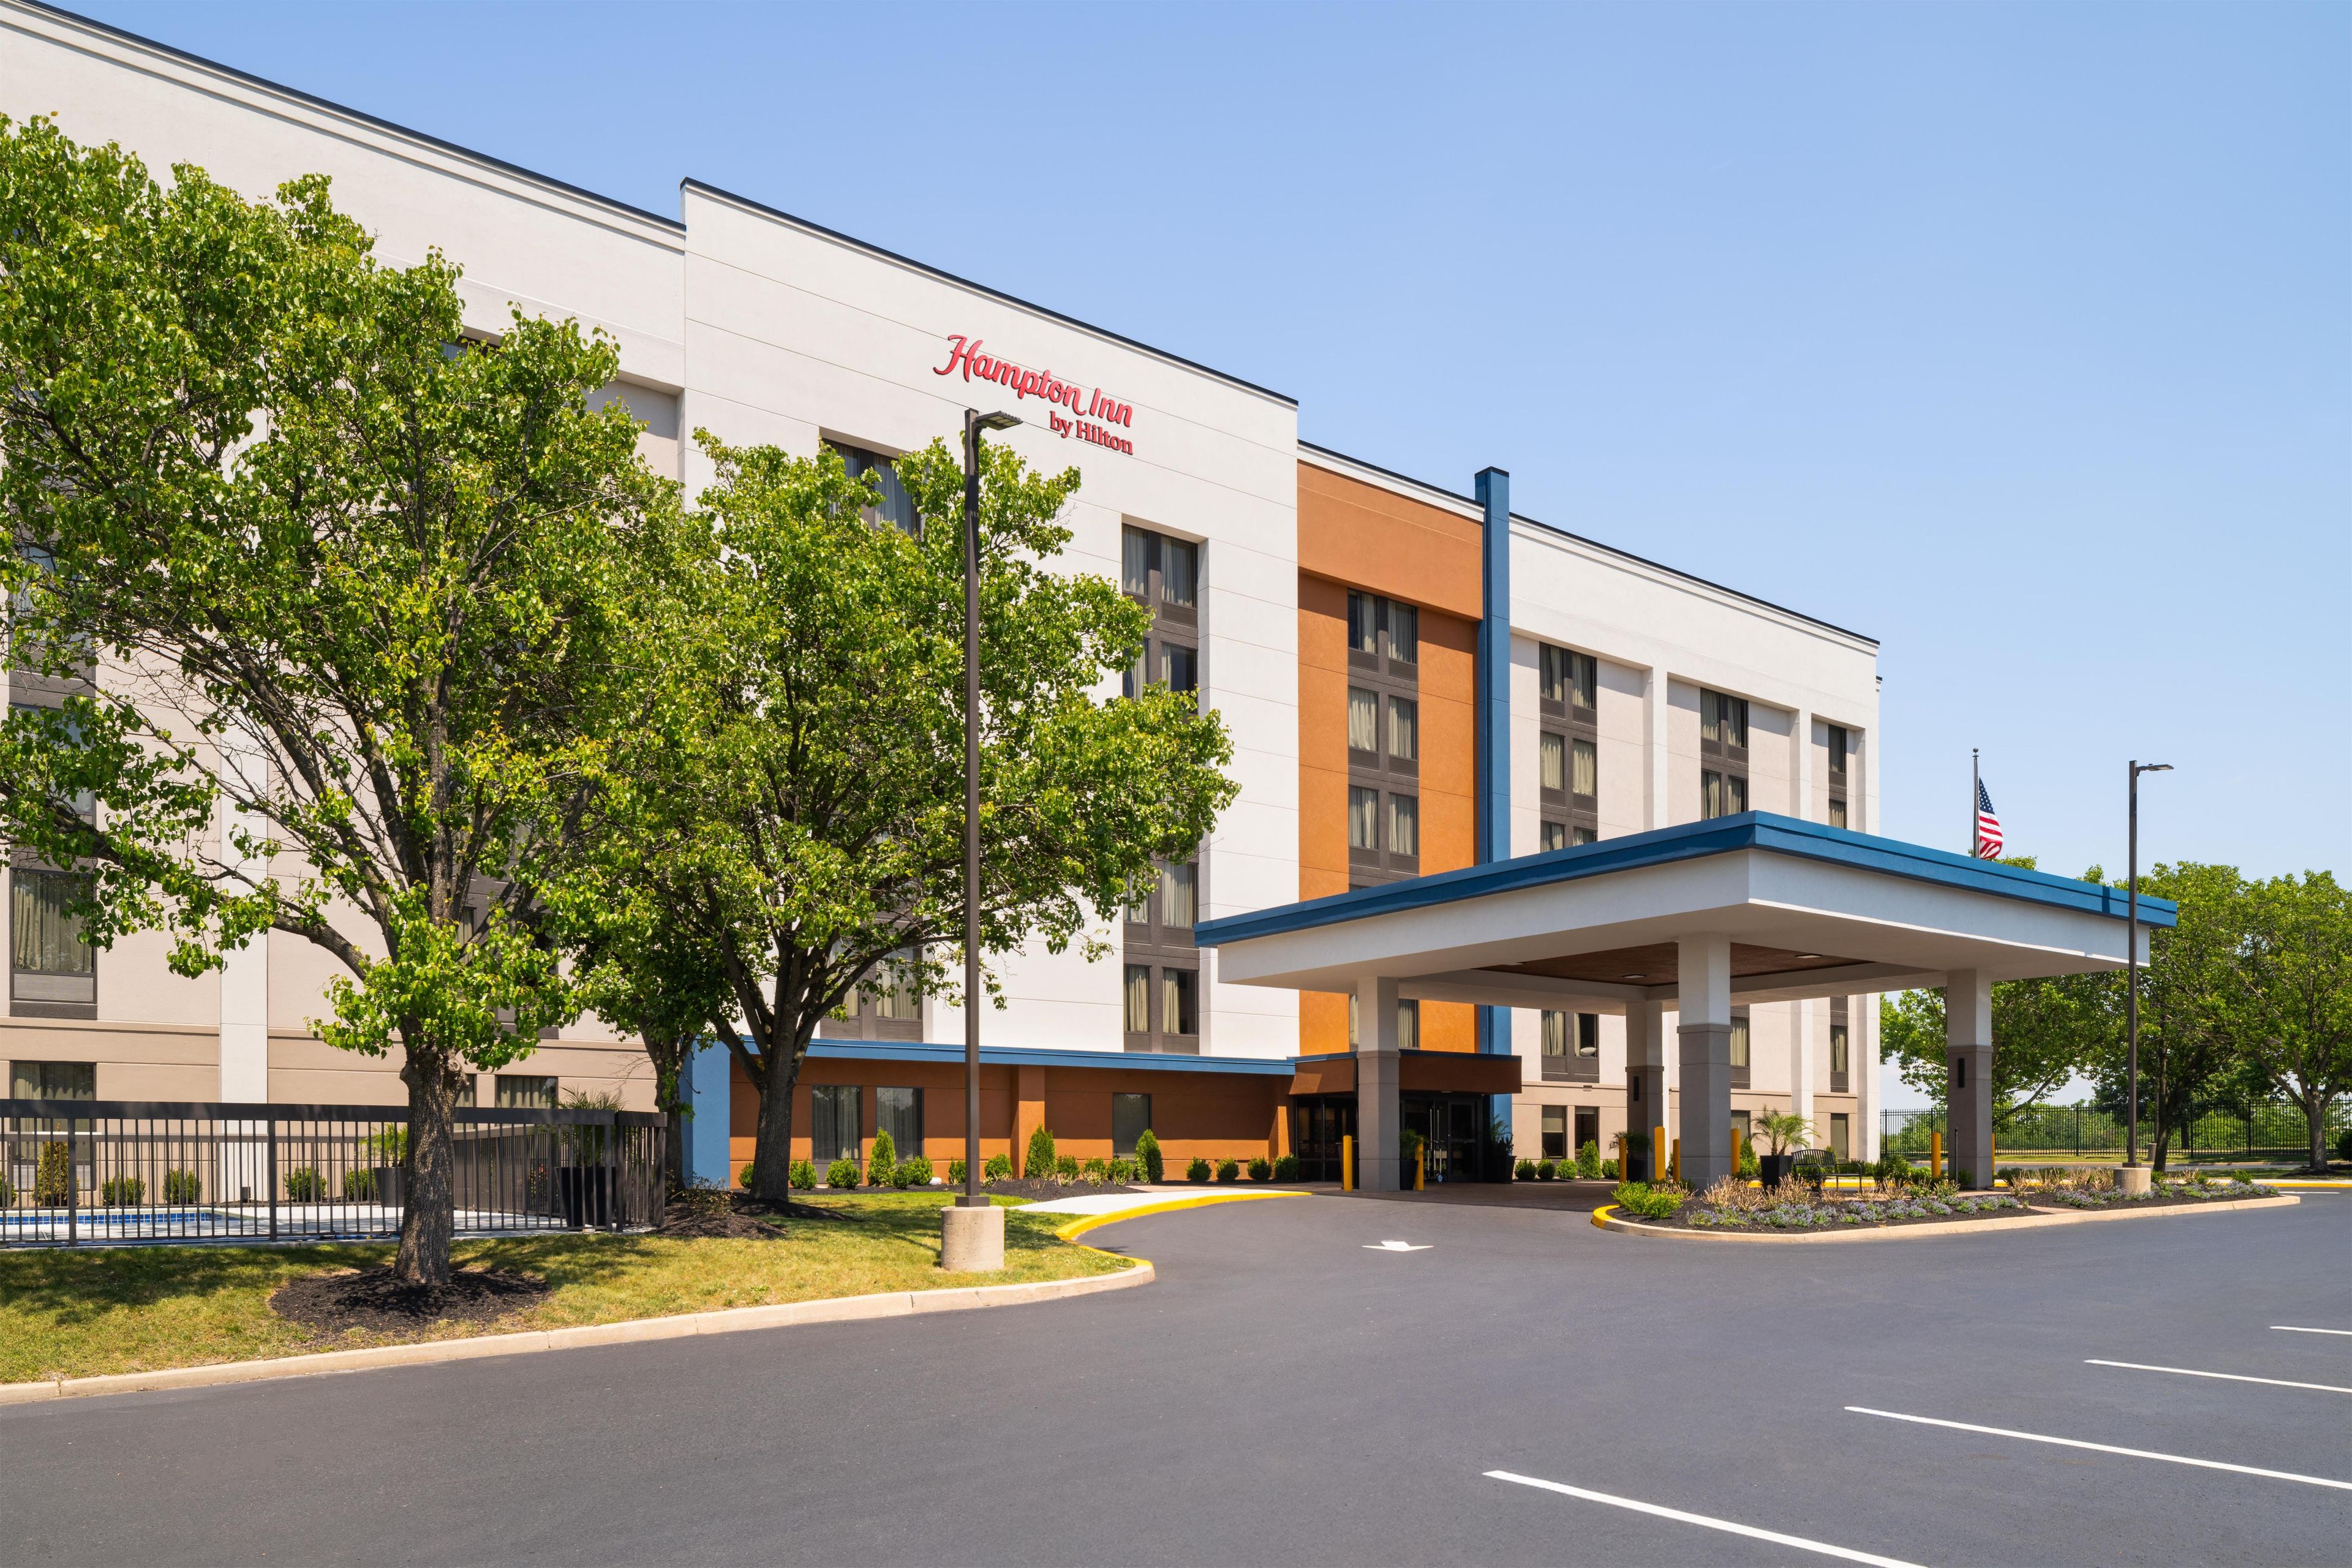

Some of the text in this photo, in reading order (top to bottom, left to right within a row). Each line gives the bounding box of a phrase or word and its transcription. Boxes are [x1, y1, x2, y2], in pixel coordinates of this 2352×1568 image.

[933, 334, 1133, 428] Hampton Inn
[1050, 411, 1134, 455] by Hilton
